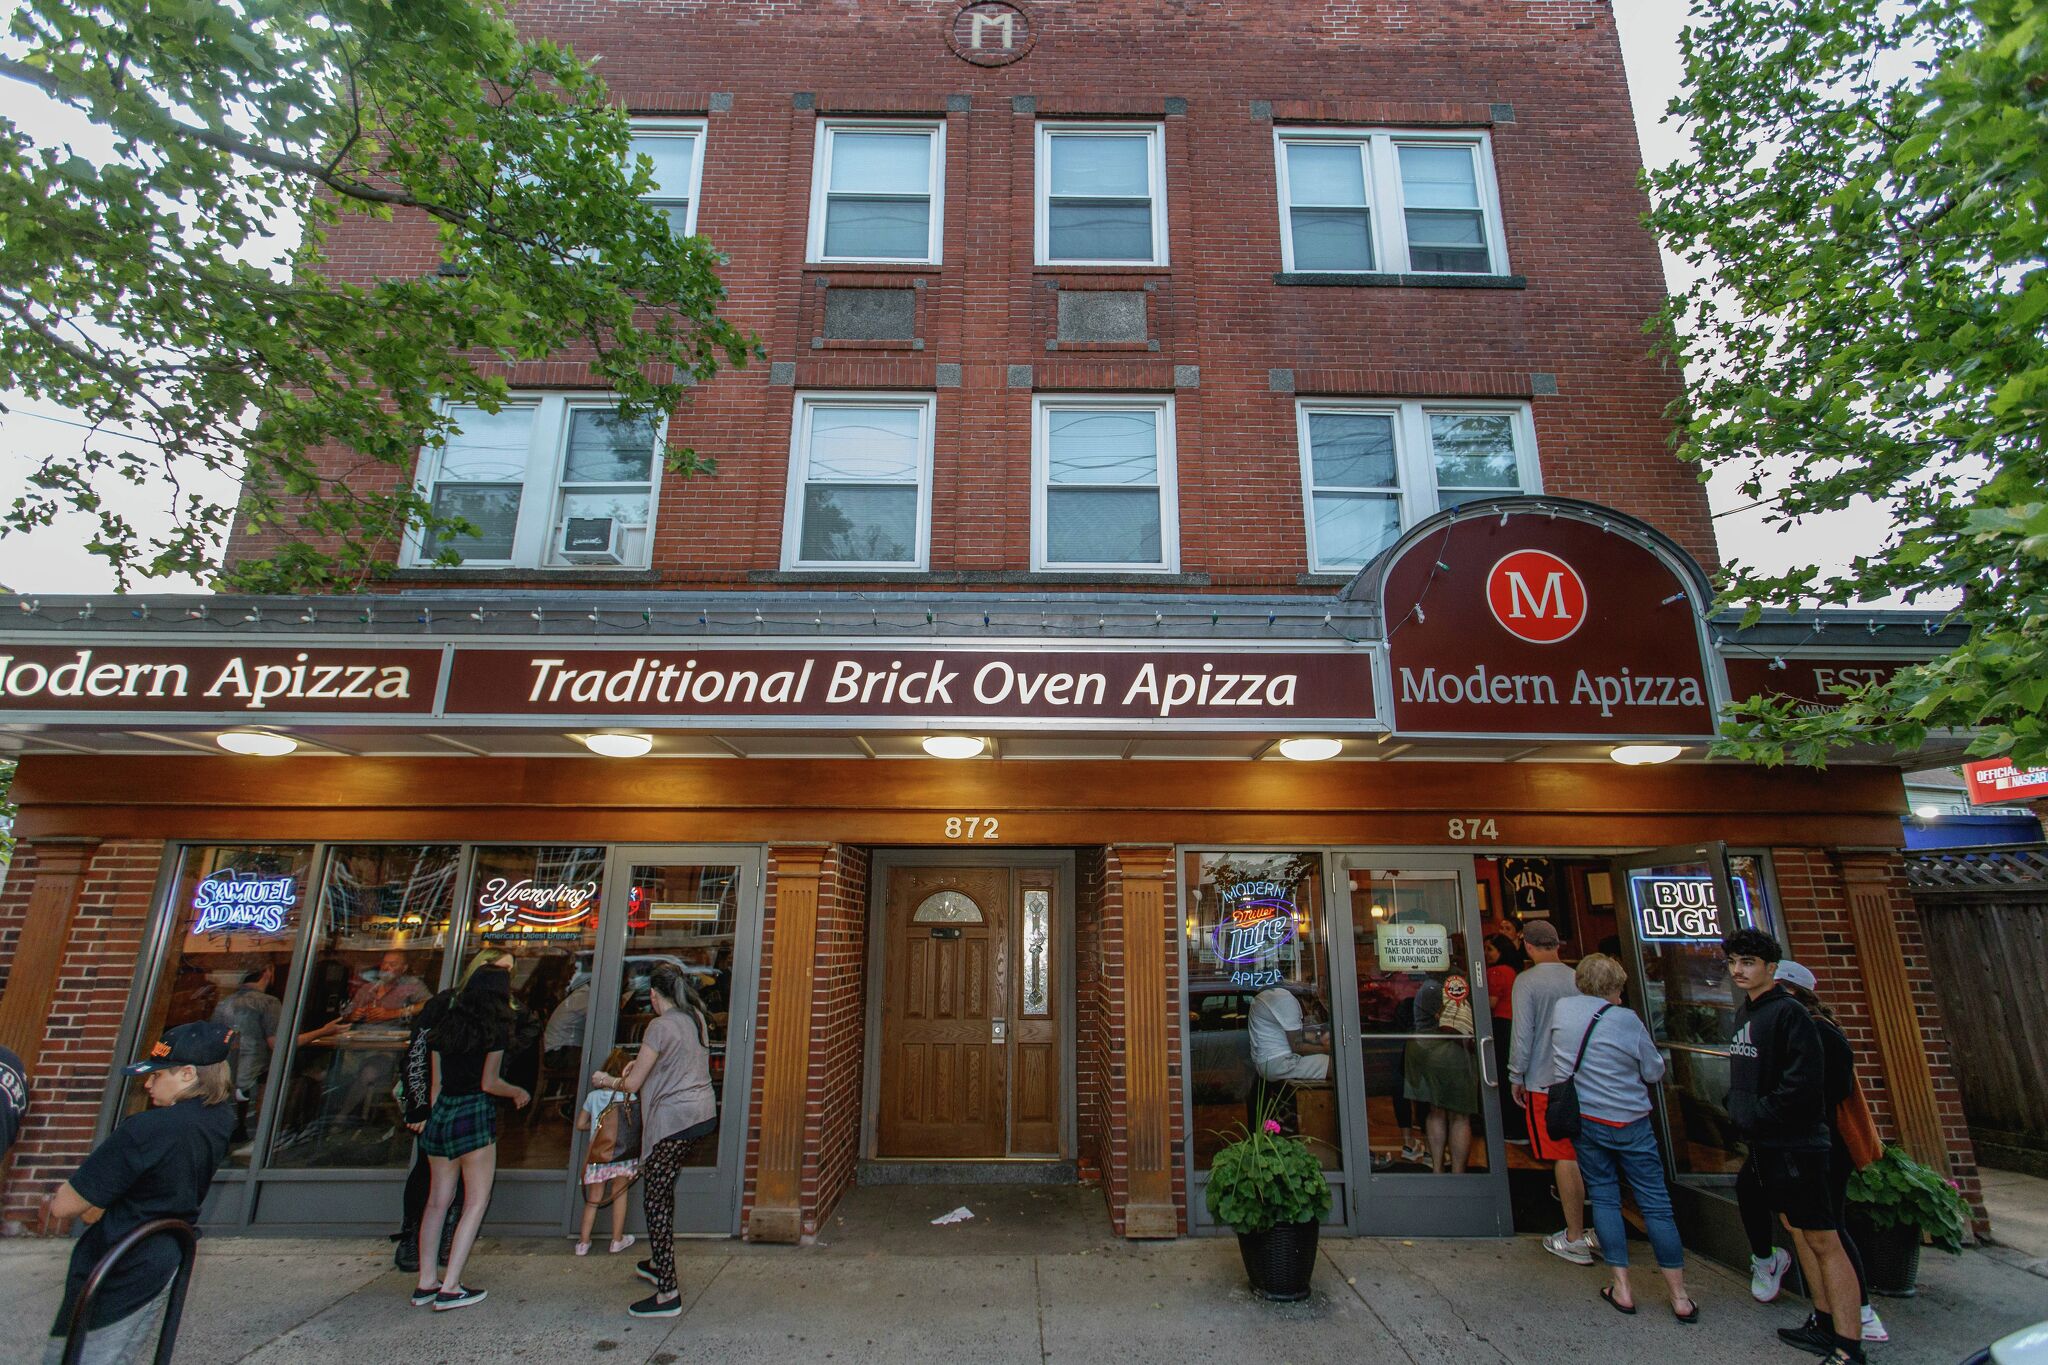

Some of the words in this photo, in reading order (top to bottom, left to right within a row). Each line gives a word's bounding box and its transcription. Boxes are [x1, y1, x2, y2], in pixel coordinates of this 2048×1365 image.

[970, 12, 1013, 49] M
[1504, 571, 1572, 619] M
[202, 652, 411, 709] Apizza
[528, 657, 815, 703] Traditional
[825, 658, 960, 704] Brick
[972, 660, 1105, 706] Oven
[1121, 661, 1299, 717] Apizza
[1399, 664, 1559, 705] Modern
[1569, 666, 1705, 718] Apizza
[2012, 771, 2046, 788] NASCAR
[944, 816, 999, 839] 872
[1448, 818, 1499, 840] 874
[1222, 881, 1287, 902] MODERN
[1513, 871, 1546, 892] YALE
[194, 878, 296, 909] SAMUEL
[479, 877, 597, 909] Yuengling
[1526, 888, 1537, 908] 4
[193, 903, 284, 935] ADAMS
[1232, 907, 1276, 923] Miller
[1386, 938, 1411, 946] PLEASE
[1412, 938, 1428, 946] PICK
[1401, 947, 1415, 955] OUT
[1416, 947, 1443, 955] ORDERS
[1230, 968, 1284, 987] APIZZA
[1729, 1041, 1758, 1058] adidas
